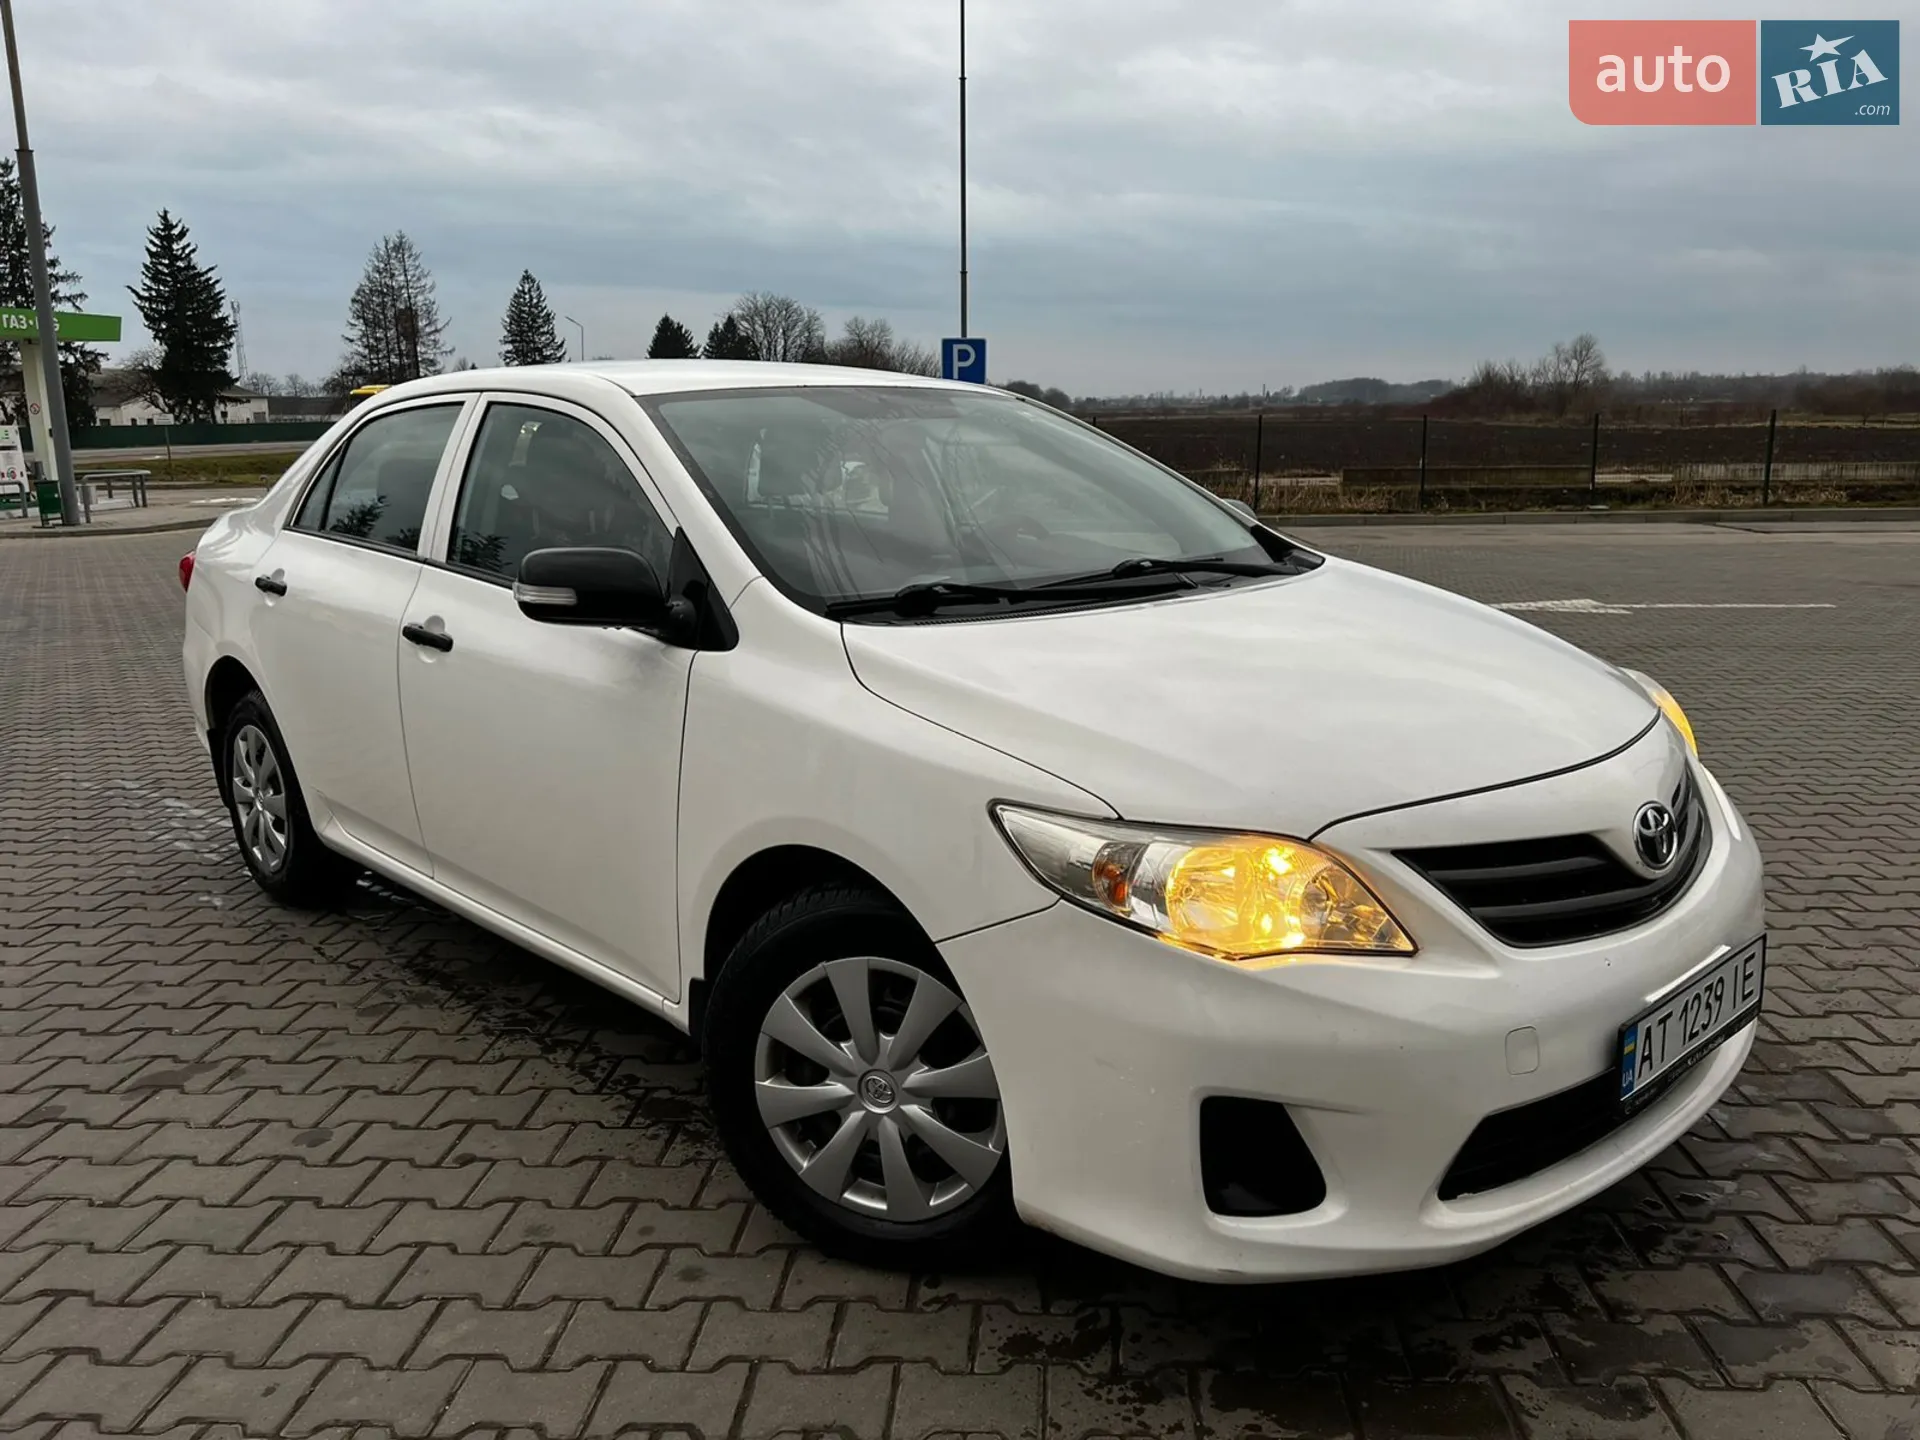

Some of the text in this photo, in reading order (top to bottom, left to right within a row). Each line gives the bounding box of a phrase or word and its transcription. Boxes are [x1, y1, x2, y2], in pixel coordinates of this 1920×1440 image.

[952, 343, 976, 380] P
[1638, 1011, 1673, 1079] AT
[1679, 975, 1725, 1046] 1239
[1733, 952, 1756, 1010] IE
[1622, 1069, 1634, 1088] UA
